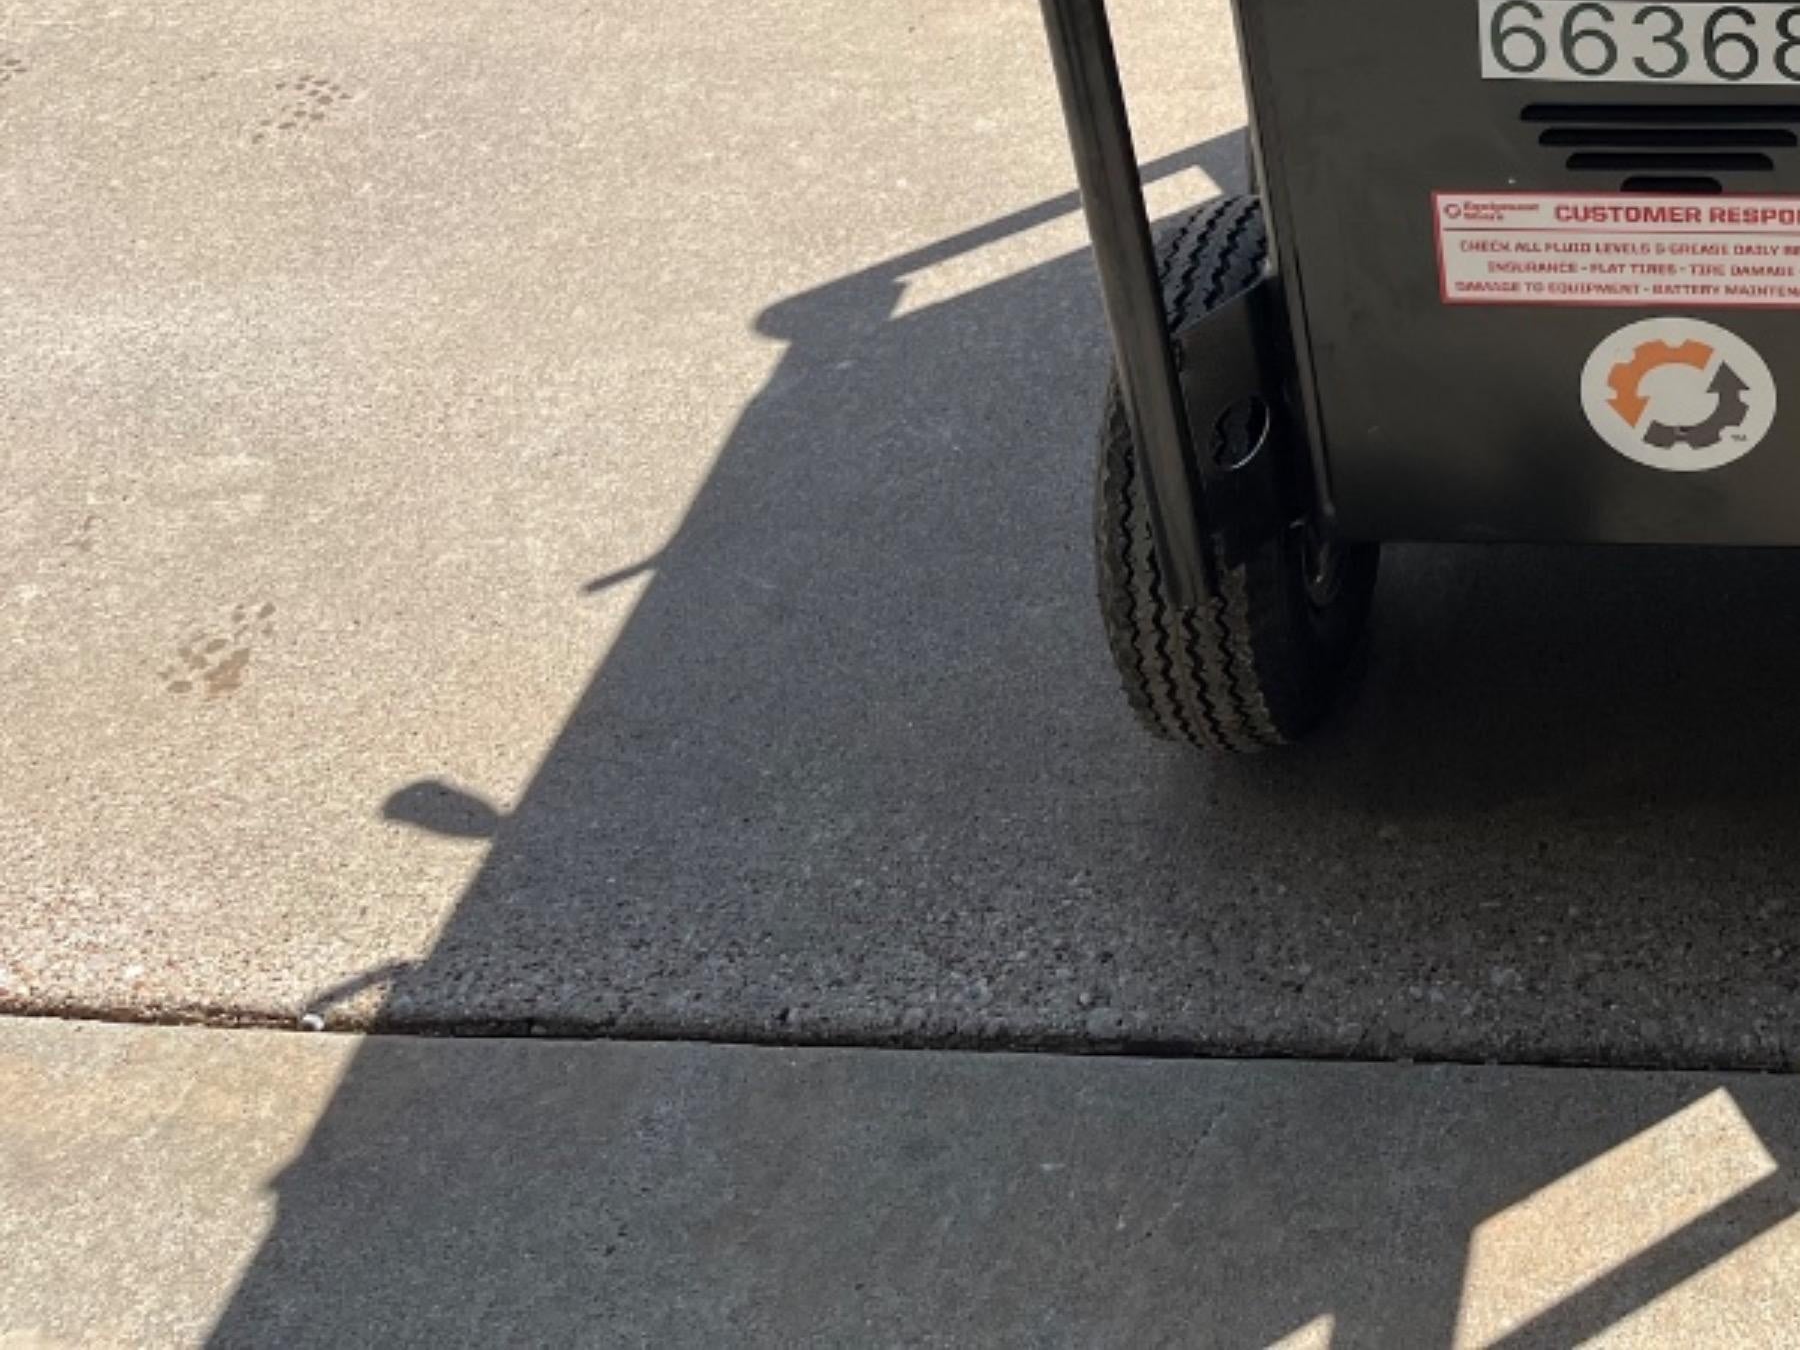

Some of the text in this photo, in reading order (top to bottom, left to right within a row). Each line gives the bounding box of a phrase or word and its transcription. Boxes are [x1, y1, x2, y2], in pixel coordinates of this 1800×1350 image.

[1555, 205, 1702, 224] CUSTOMER
[1459, 240, 1510, 253] CHECK
[1514, 241, 1542, 253] ALL
[1544, 242, 1591, 254] FLUID
[1595, 242, 1651, 254] LEVELS
[1733, 244, 1780, 257] DAILY
[1487, 261, 1578, 274] INSURANCE
[1590, 262, 1626, 275] FLAT
[1630, 263, 1677, 276] TIRES
[1690, 264, 1726, 277] TIRE
[1731, 265, 1795, 278] DAMAGE
[1525, 282, 1545, 293] TO
[1547, 282, 1640, 295] EQUIPMENT
[1652, 284, 1720, 297] BATTERY
